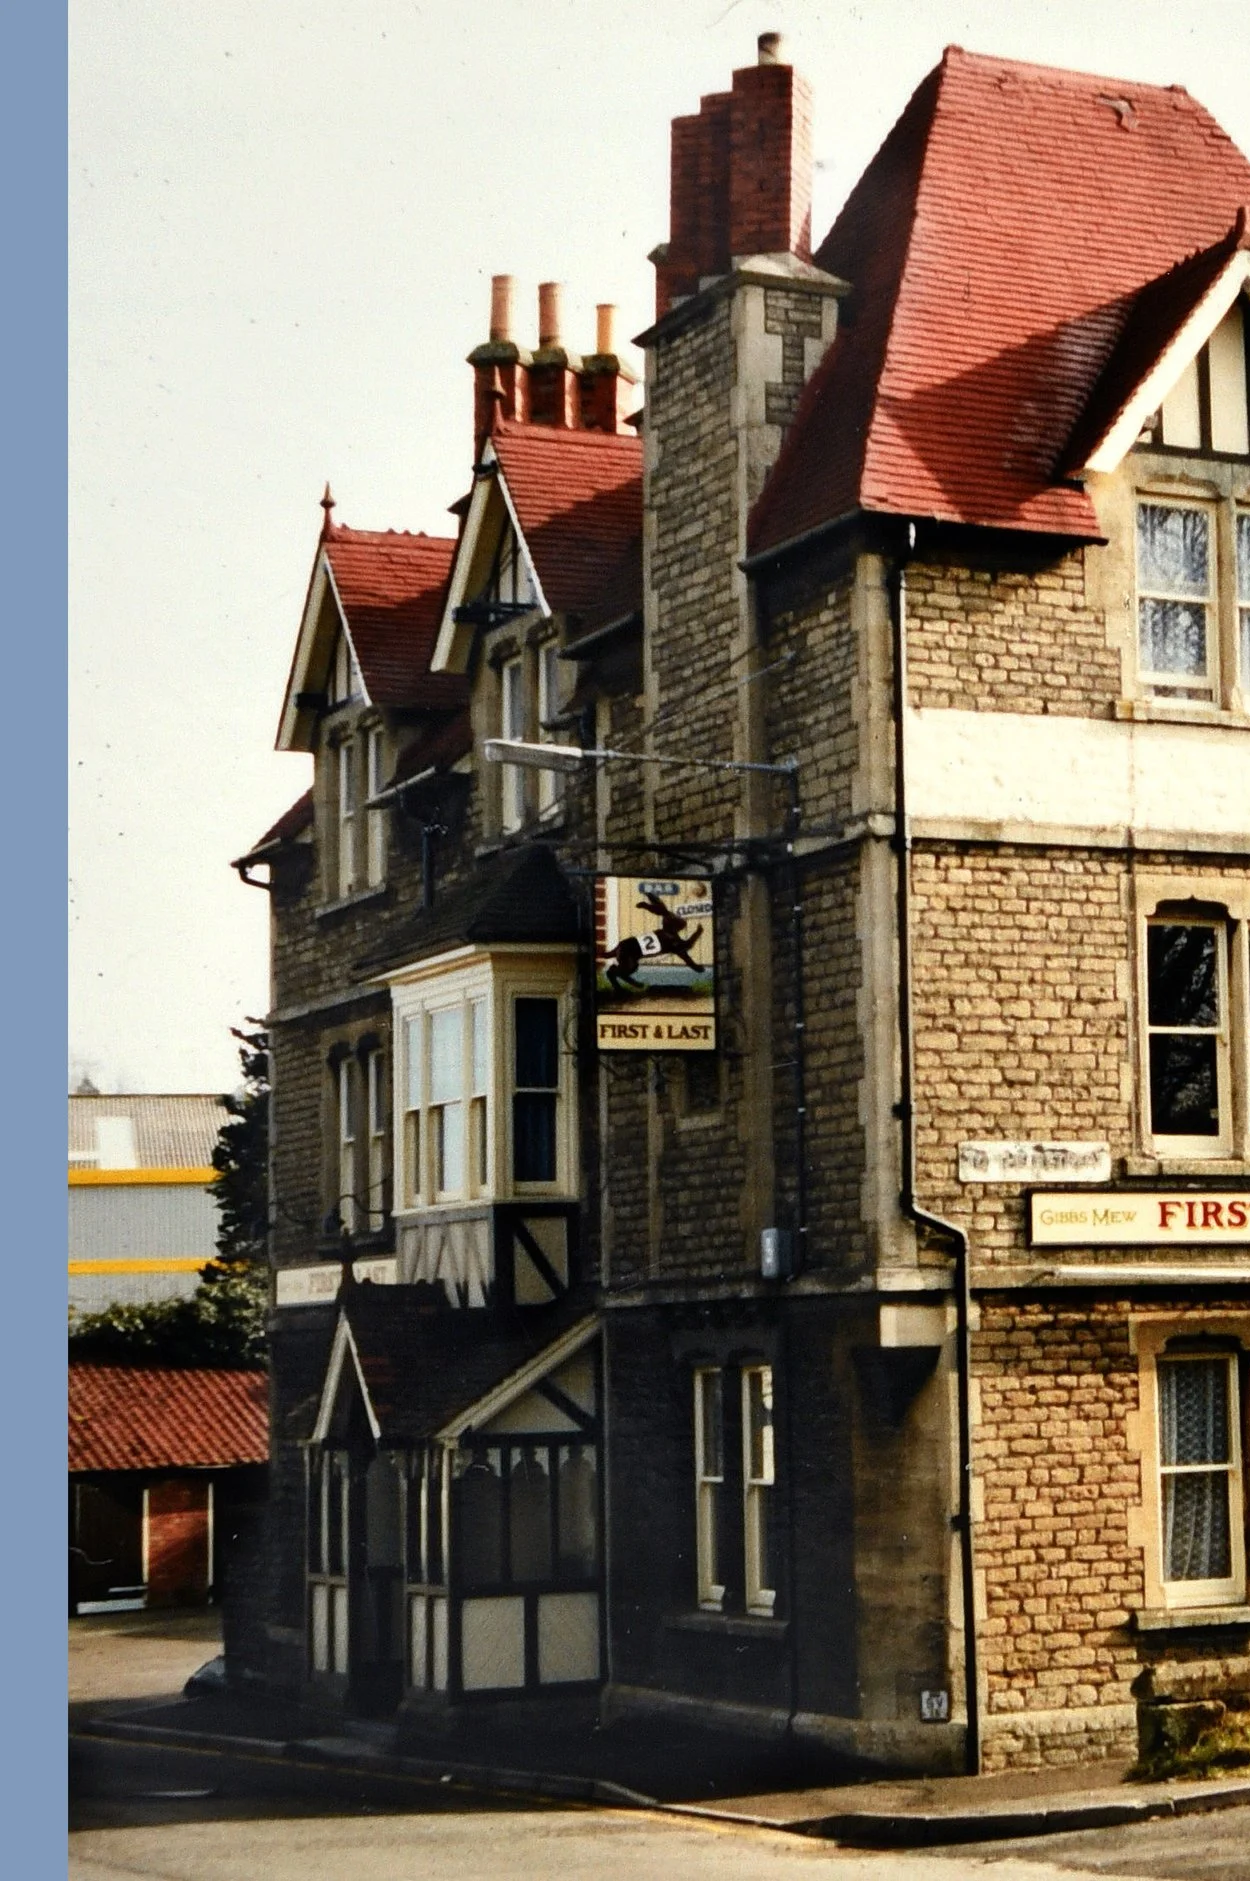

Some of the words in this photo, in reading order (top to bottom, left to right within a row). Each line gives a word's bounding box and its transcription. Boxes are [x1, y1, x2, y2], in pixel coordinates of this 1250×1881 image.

[677, 903, 713, 916] CLOSED
[643, 936, 656, 950] 2
[600, 1024, 648, 1039] FIRST
[653, 1025, 663, 1039] &
[667, 1025, 711, 1040] LAST
[1040, 1209, 1088, 1226] GIBBS
[1092, 1208, 1137, 1227] MEW
